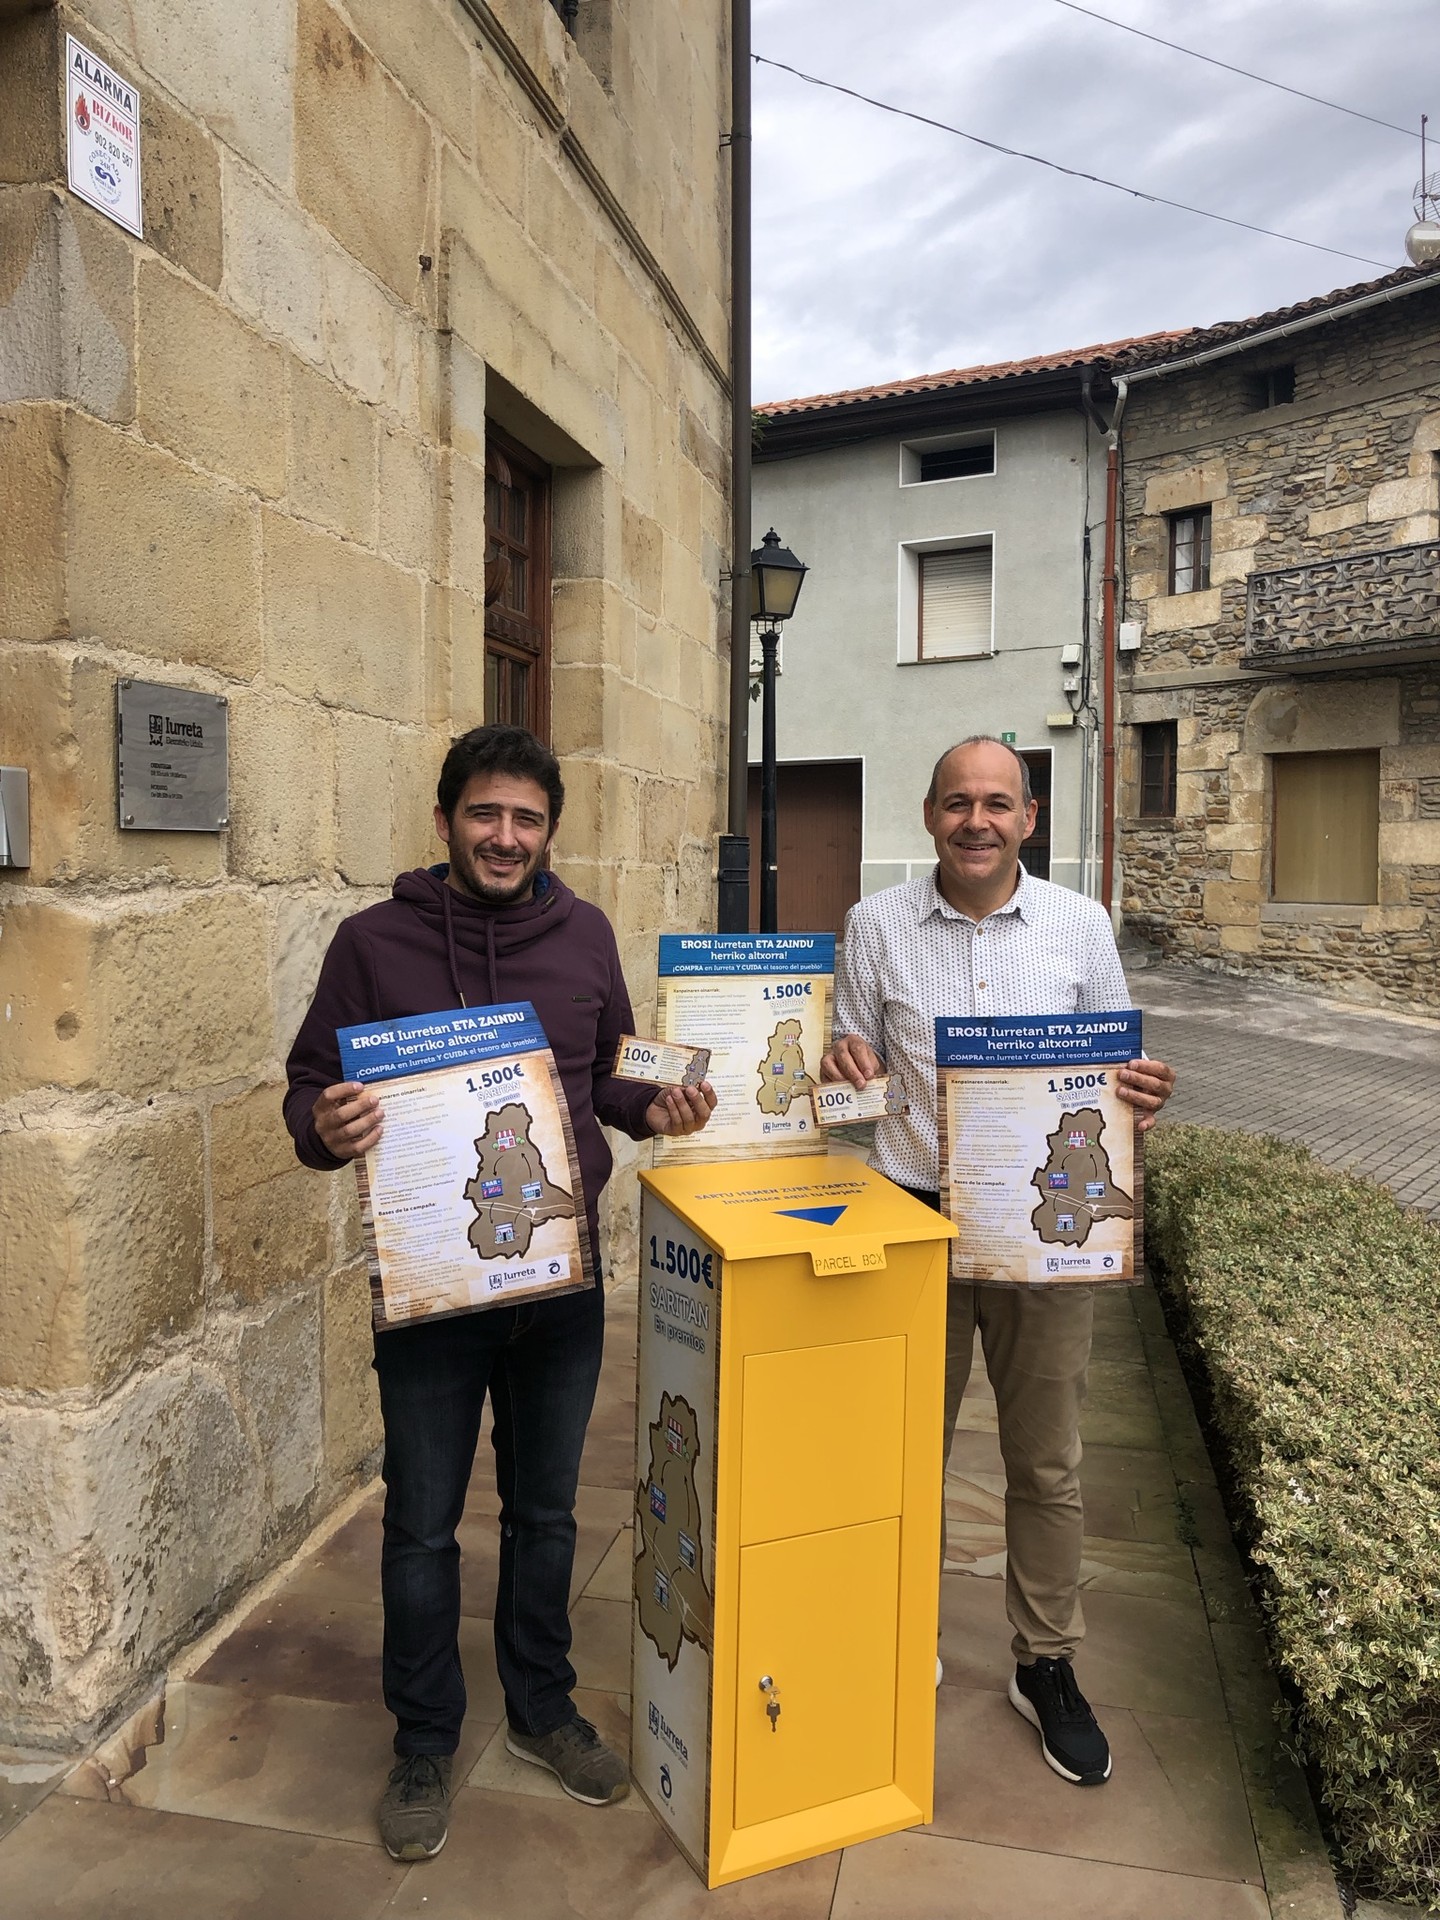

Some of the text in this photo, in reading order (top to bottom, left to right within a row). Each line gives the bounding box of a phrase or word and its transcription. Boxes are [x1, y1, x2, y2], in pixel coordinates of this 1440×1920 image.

[74, 52, 133, 113] ALARMA
[92, 99, 133, 143] BIZKOR
[94, 131, 107, 150] 902
[108, 141, 120, 160] 820
[121, 152, 133, 169] 587
[165, 716, 203, 738] Iurreta
[681, 939, 814, 949] EROSI Iurretan ETA ZAINDU
[711, 951, 788, 960] herriko altxorra!
[800, 963, 823, 971] pueblo!
[762, 982, 813, 1000] 1.500€
[350, 1011, 525, 1050] EROSI Iurretan ETA ZAINDU
[947, 1022, 1128, 1038] EROSI Iurretan ETA ZAINDU
[396, 1029, 499, 1056] herriko altxorra!
[987, 1037, 1092, 1050] herriko altxorra!
[356, 1063, 397, 1079] ¡COMPRA
[397, 1061, 408, 1069] en
[409, 1056, 436, 1067] Iurreta
[443, 1050, 469, 1060] CUIDA
[469, 1047, 477, 1055] el
[477, 1044, 500, 1054] tesoro
[500, 1041, 512, 1050] del
[512, 1037, 538, 1049] pueblo!
[622, 1046, 658, 1065] 100€
[947, 1054, 984, 1062] ¡COMPRA
[1066, 1052, 1090, 1060] tesoro
[1090, 1050, 1103, 1058] del
[1104, 1049, 1132, 1059] pueblo!
[466, 1063, 524, 1093] 1.500€
[1047, 1072, 1107, 1093] 1.500€
[477, 1080, 521, 1102] SARITAN
[817, 1092, 853, 1108] 100€
[1056, 1088, 1101, 1102] SARITAN
[771, 1121, 791, 1129] Iurreta
[694, 1192, 734, 1200] SARTU
[735, 1188, 779, 1197] HEMEN
[811, 1181, 871, 1190] TXARTELA
[722, 1196, 781, 1205] Introduce
[378, 1209, 395, 1217] Bases
[650, 1234, 714, 1290] 1.500€
[815, 1253, 884, 1271] PARCEL BOX
[1061, 1257, 1091, 1265] Iurreta
[503, 1268, 536, 1280] Iurreta
[650, 1282, 710, 1331] SARITAN
[654, 1315, 706, 1354] En premios
[660, 1714, 689, 1761] Iurreta
